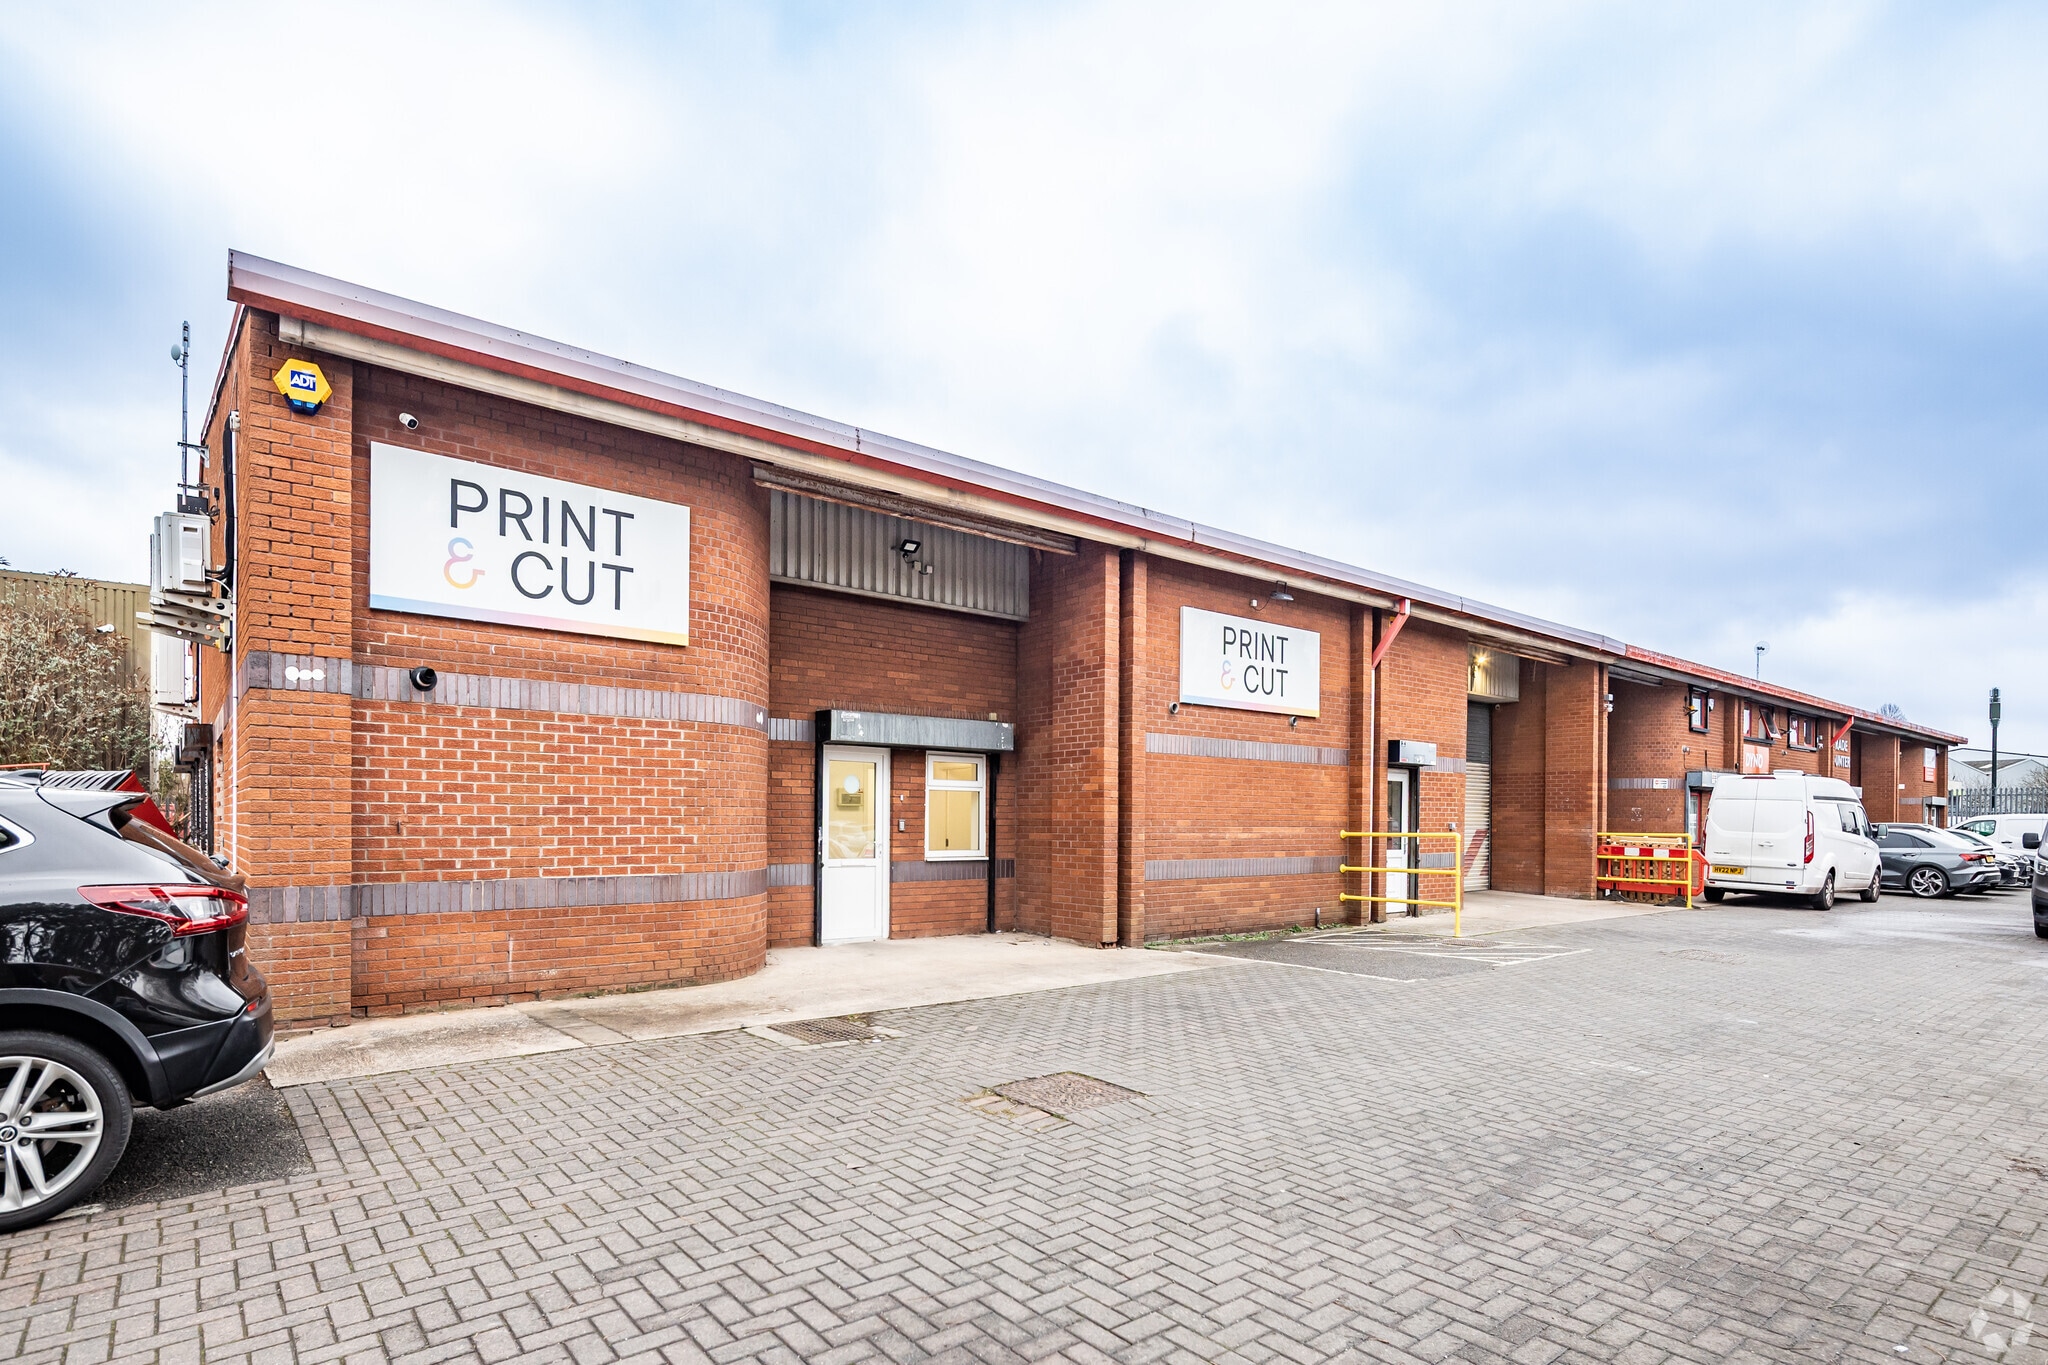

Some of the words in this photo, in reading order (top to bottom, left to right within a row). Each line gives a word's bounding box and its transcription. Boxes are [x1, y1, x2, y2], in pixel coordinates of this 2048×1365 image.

[290, 373, 317, 389] ADT
[450, 478, 635, 557] PRINT
[443, 537, 486, 590] &
[510, 551, 634, 611] CUT
[1223, 625, 1289, 665] PRINT
[1221, 660, 1236, 690] &
[1243, 664, 1288, 697] CUT
[1745, 751, 1764, 769] DYNO
